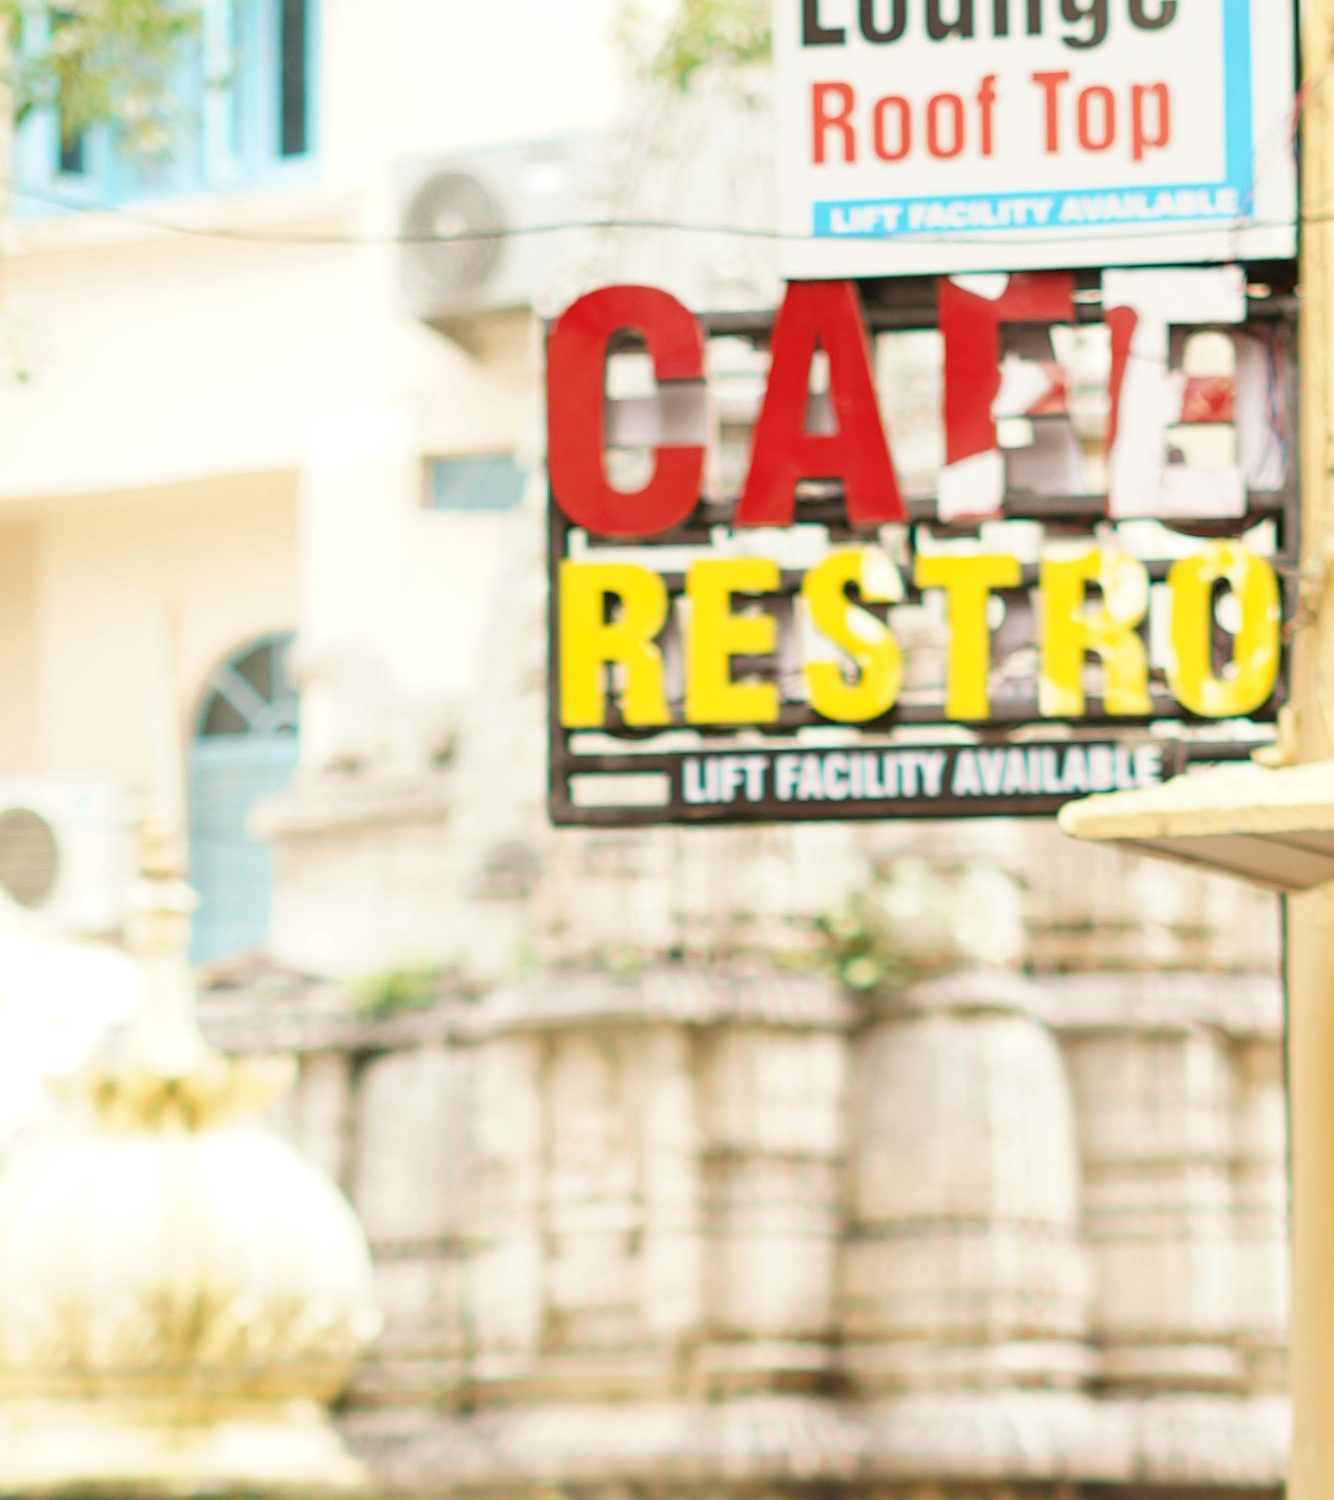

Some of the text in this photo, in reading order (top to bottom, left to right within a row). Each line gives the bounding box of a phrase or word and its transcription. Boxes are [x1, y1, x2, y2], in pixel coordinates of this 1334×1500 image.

[810, 69, 1172, 167] Roof Top
[828, 187, 1239, 235] LIFT FACILITY AVAILABLE
[545, 264, 1249, 538] CAFE
[558, 539, 1282, 729] RESTRO
[680, 744, 1166, 804] LIFT FACILITY AVAILABLE
